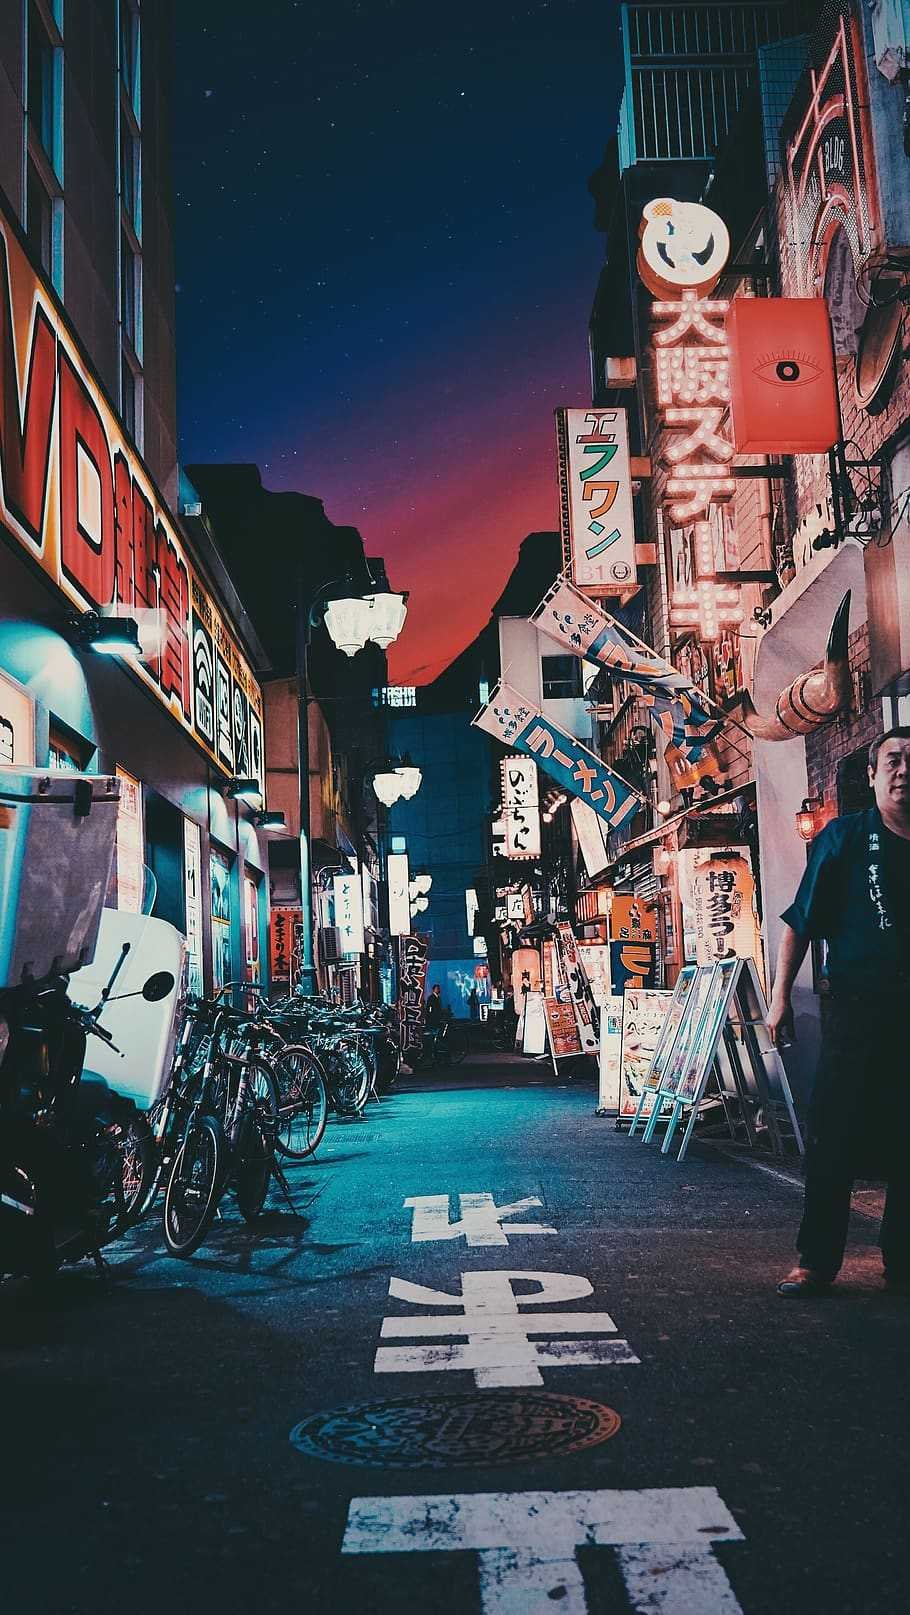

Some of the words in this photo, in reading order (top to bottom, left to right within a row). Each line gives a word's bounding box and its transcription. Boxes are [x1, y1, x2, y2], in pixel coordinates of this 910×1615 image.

[576, 413, 621, 560] エフワン
[652, 289, 743, 640] 大阪ステーキ
[569, 613, 600, 648] 多食堂
[508, 770, 530, 850] のぶちゃん
